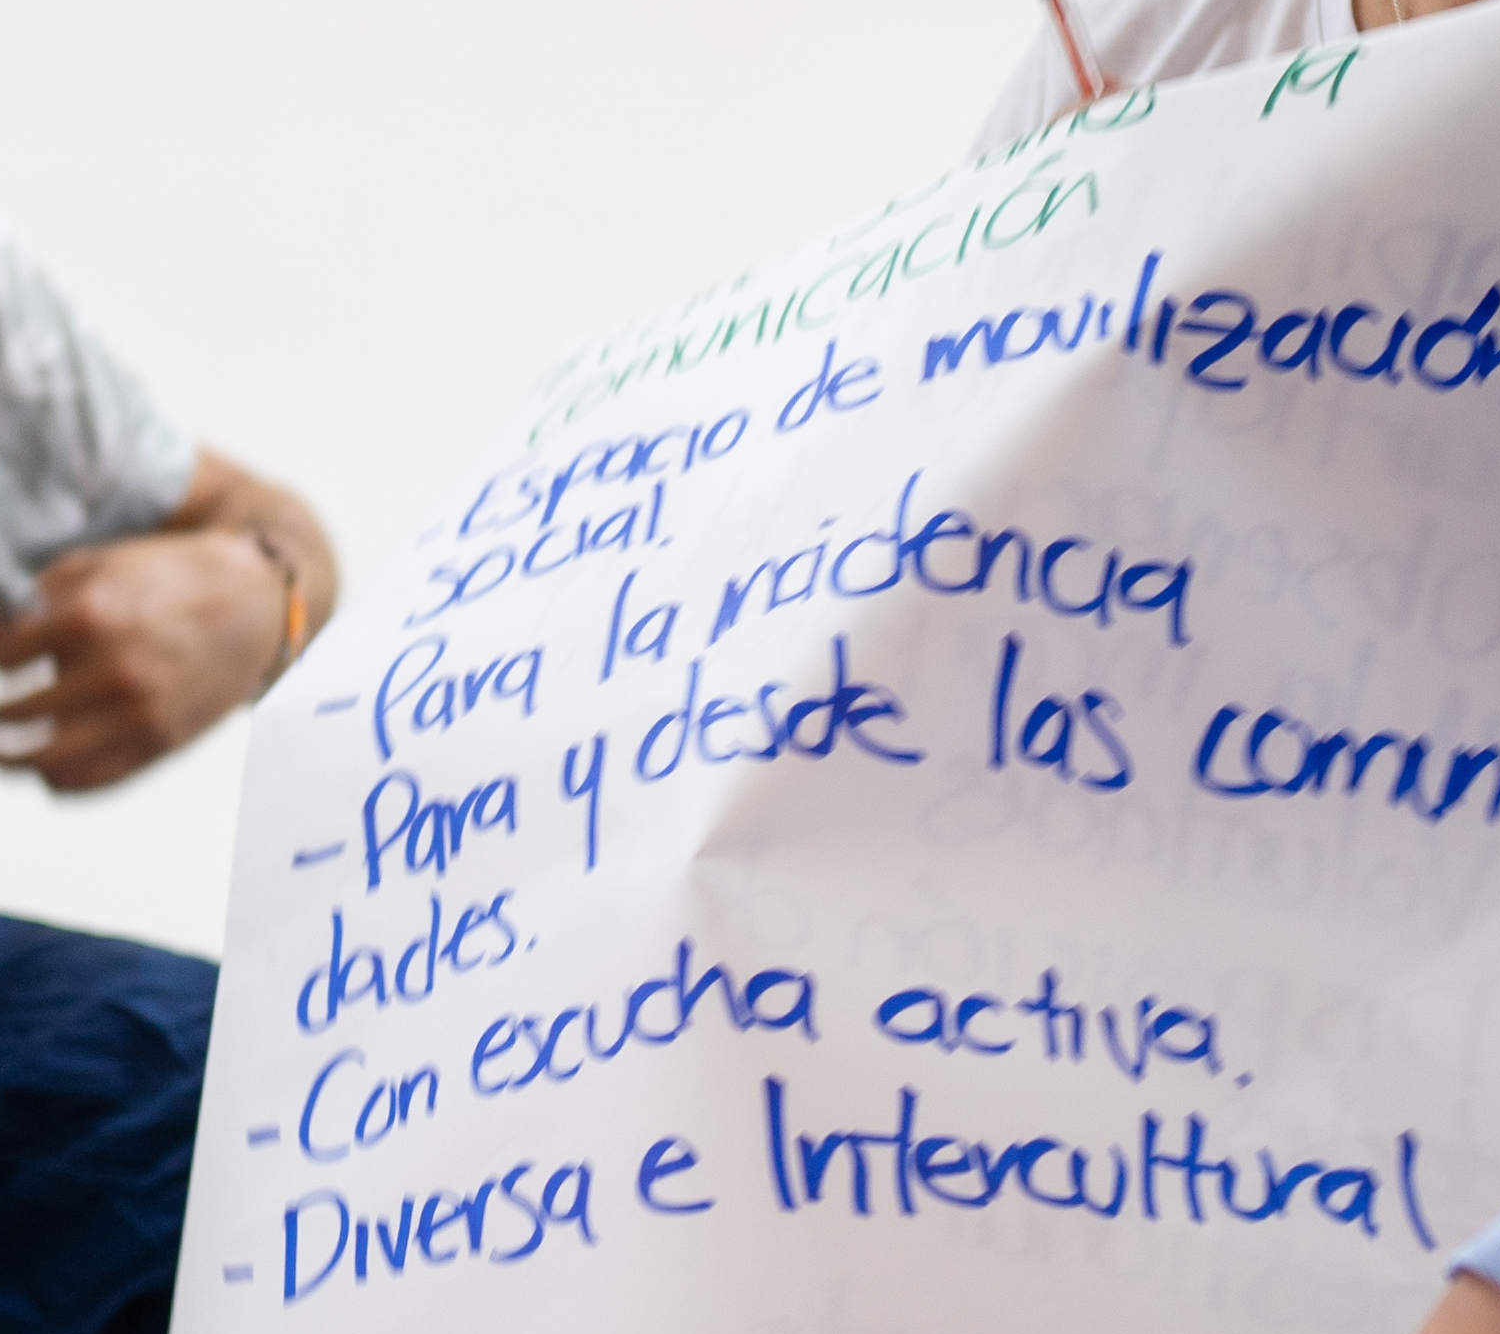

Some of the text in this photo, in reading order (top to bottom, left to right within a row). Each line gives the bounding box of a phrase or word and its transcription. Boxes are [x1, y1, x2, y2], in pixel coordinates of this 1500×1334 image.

[773, 335, 884, 433] de
[597, 567, 683, 685] la
[559, 731, 609, 873] y
[632, 632, 926, 785] desde
[986, 630, 1135, 795] las
[295, 888, 539, 1036] dades.
[469, 936, 823, 1098] escucha
[872, 966, 1255, 1088] activa.
[635, 1135, 717, 1216] e
[760, 1074, 1437, 1254] Intercultural
